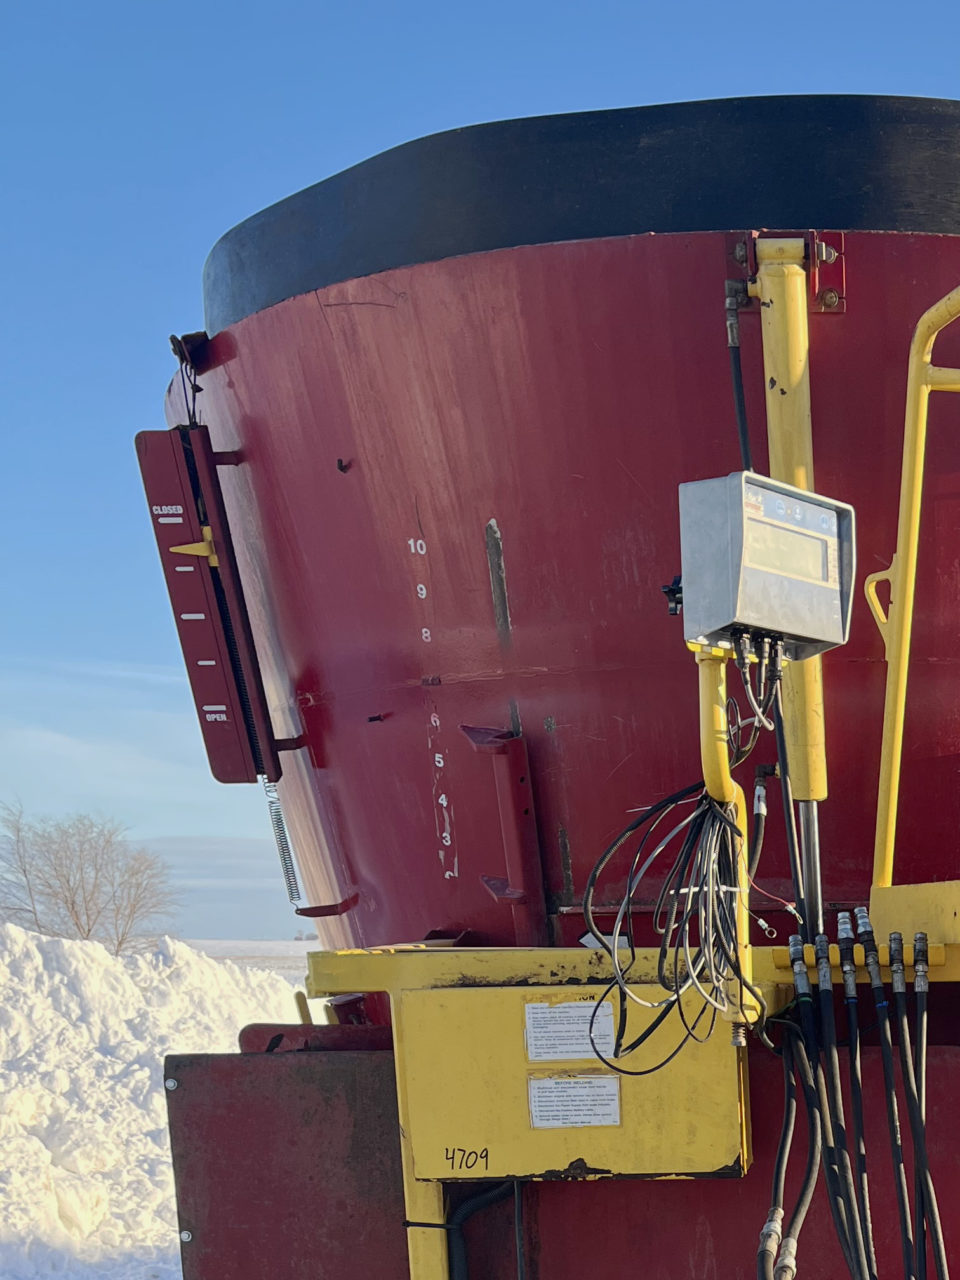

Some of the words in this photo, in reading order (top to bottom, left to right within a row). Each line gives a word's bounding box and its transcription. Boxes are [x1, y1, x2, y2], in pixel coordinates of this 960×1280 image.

[152, 505, 184, 514] CLOSED
[408, 538, 427, 555] 10
[416, 584, 427, 599] 9
[421, 628, 432, 642] 8
[205, 713, 227, 721] OPEN
[434, 753, 445, 768] 5
[438, 794, 448, 807] 4
[442, 832, 452, 846] 3
[445, 1147, 488, 1171] 4709
